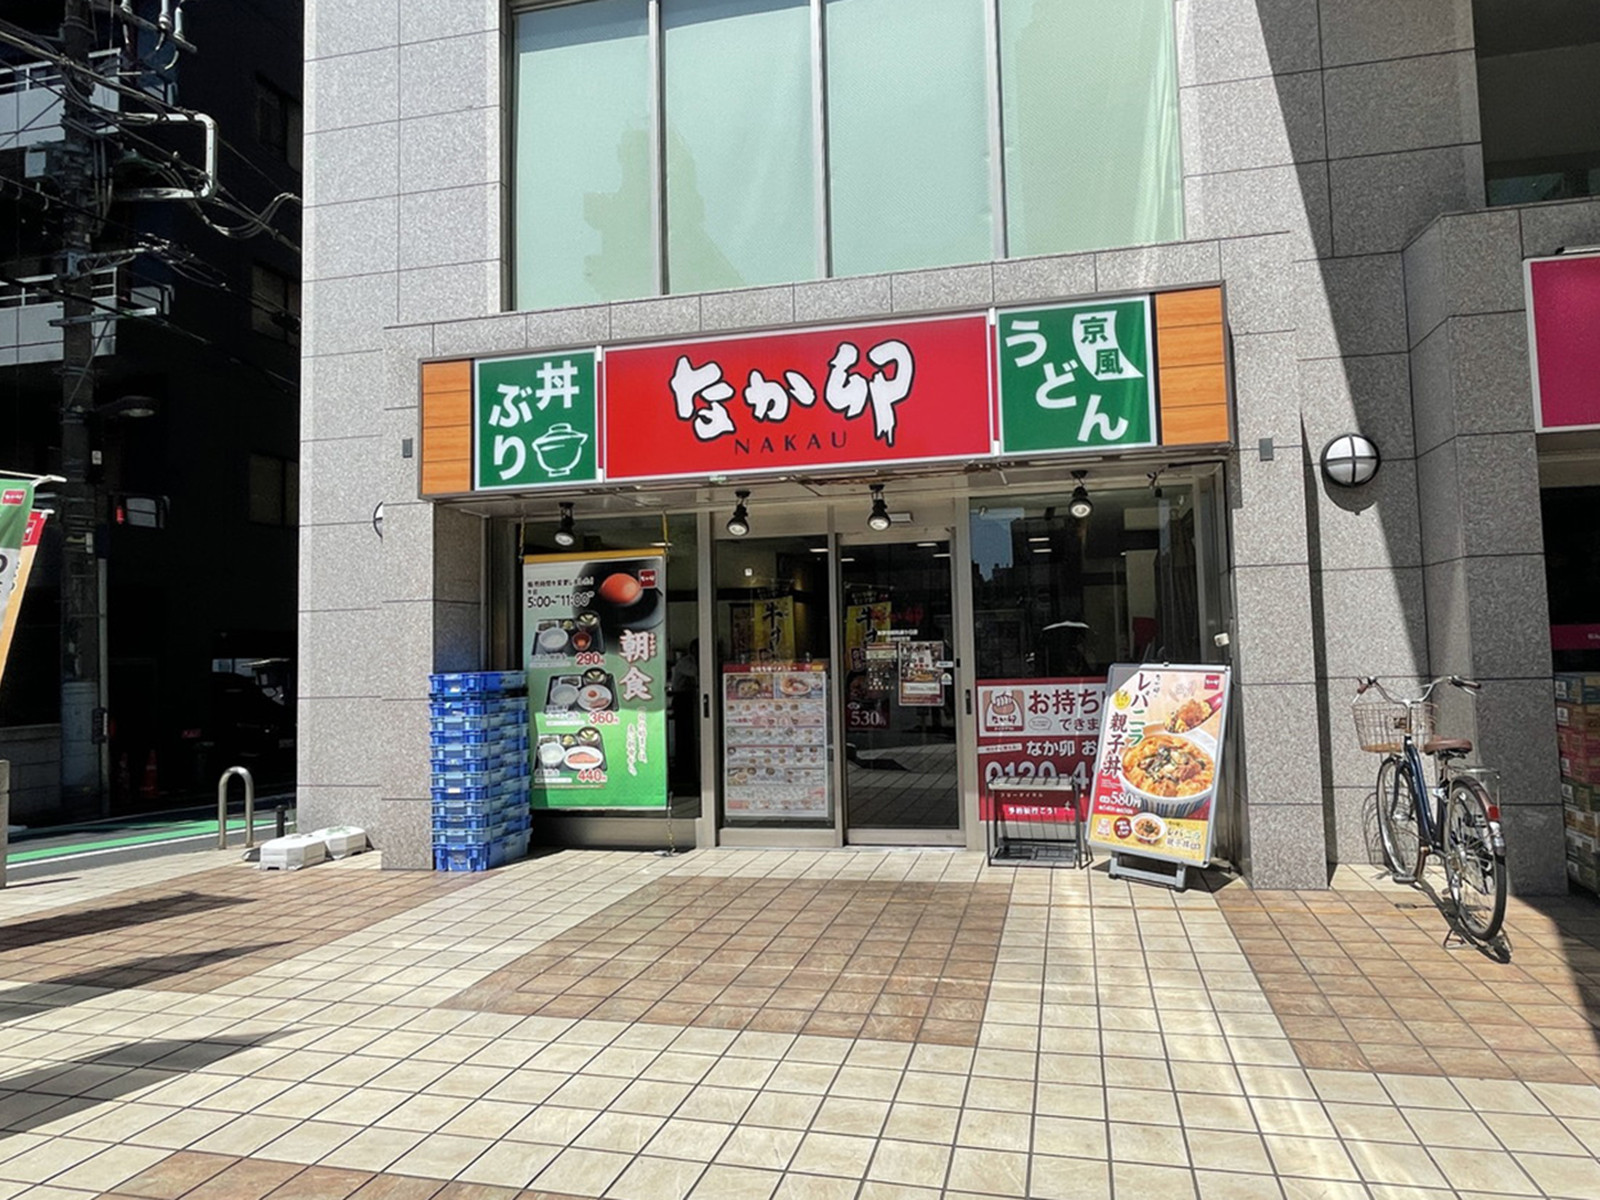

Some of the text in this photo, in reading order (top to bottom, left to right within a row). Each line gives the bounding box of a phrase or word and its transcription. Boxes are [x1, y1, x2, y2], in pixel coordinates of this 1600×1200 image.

[1080, 316, 1124, 376] 京風
[669, 339, 915, 447] なか卯
[1005, 319, 1129, 442] うどん
[735, 432, 847, 455] NAKAU
[619, 629, 653, 703] 朝食
[1028, 688, 1108, 715] お持ち
[1128, 672, 1151, 747] レバニラ
[985, 760, 1098, 790] 0120-4
[1026, 740, 1075, 757] なか卯
[1103, 711, 1128, 778] 親子丼
